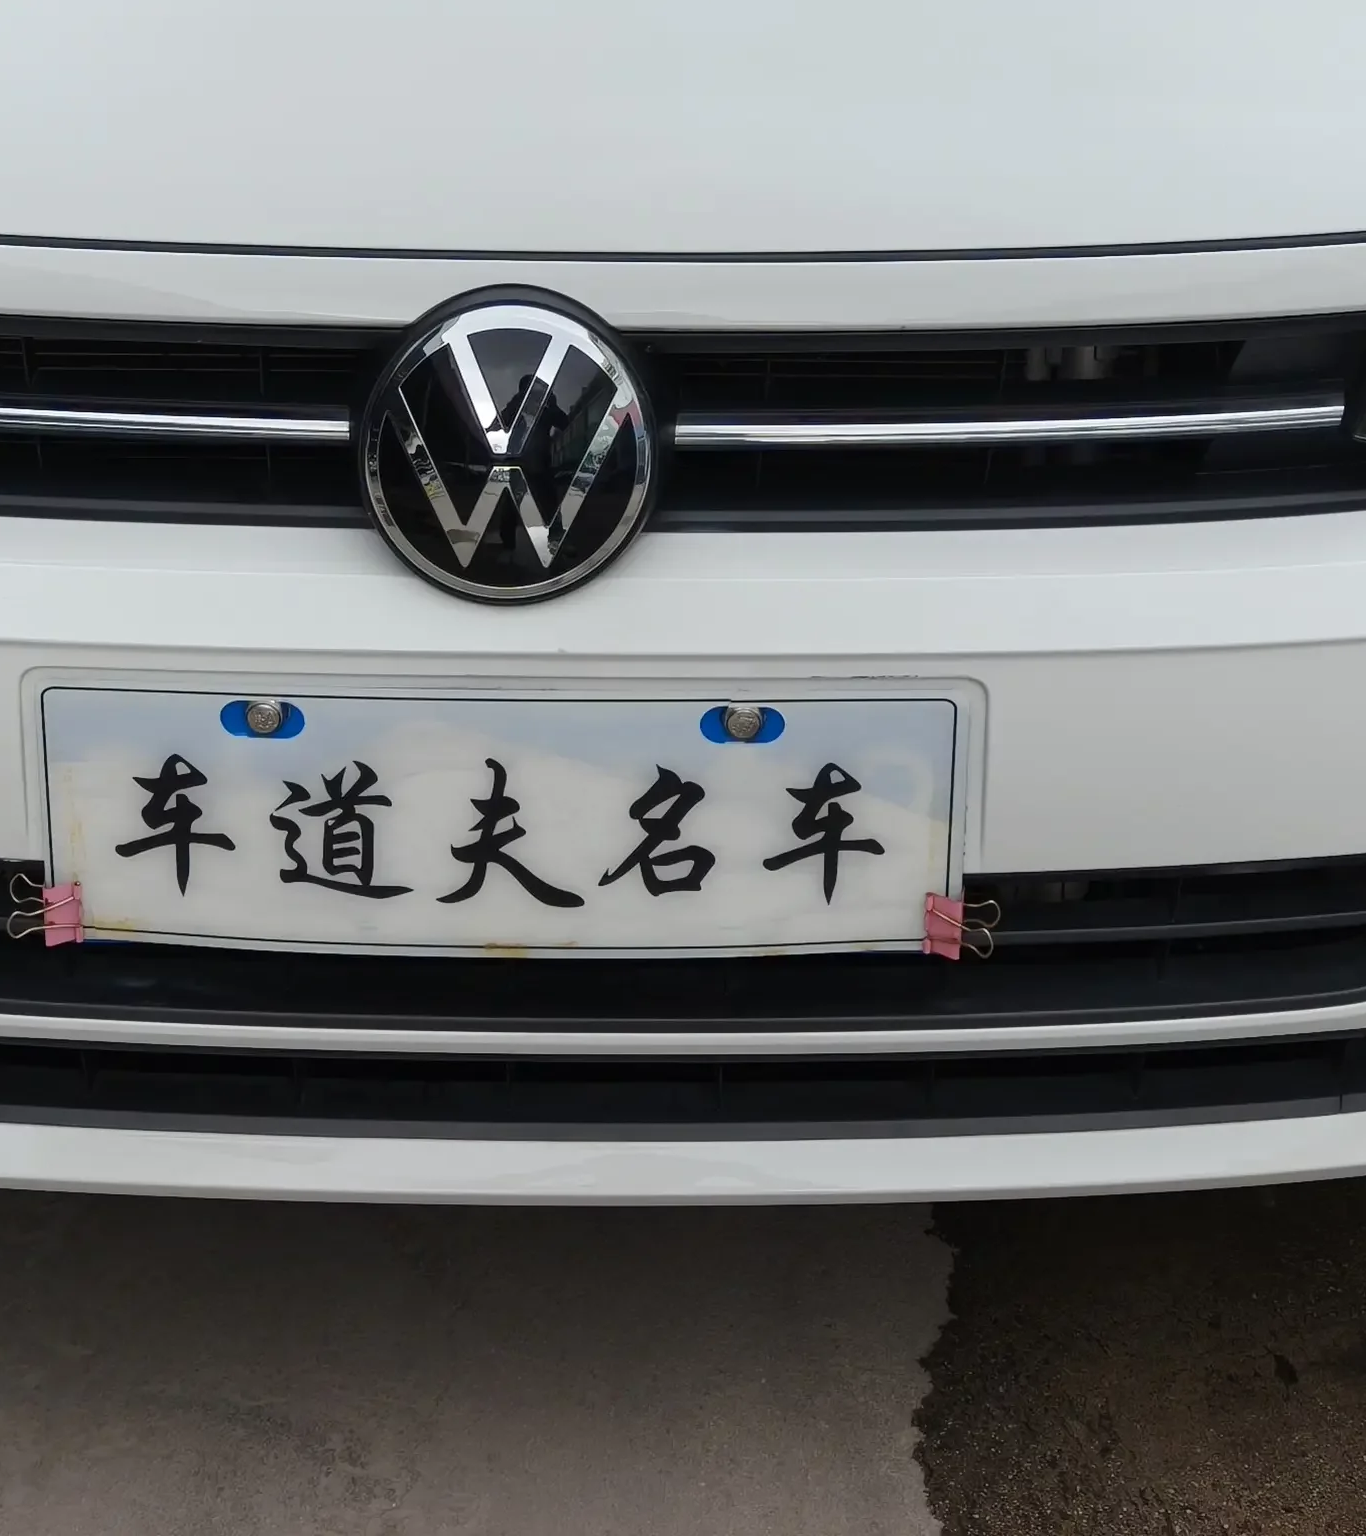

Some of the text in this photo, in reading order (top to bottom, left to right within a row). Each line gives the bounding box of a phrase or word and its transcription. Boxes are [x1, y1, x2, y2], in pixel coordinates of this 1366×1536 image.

[115, 753, 885, 908] 车道夫名车
